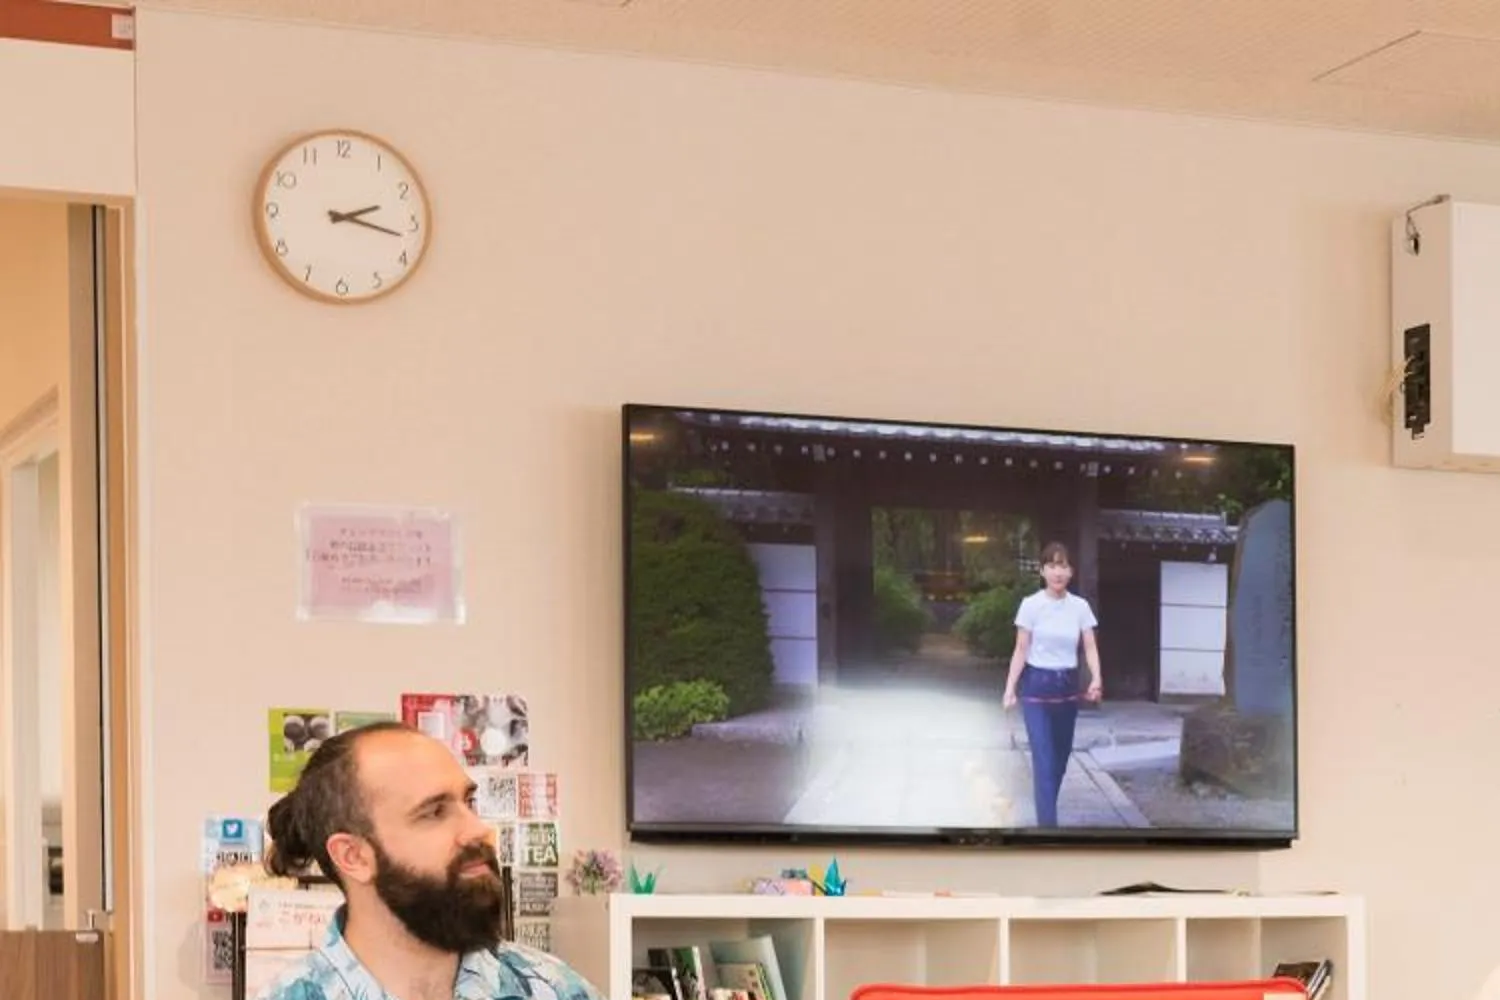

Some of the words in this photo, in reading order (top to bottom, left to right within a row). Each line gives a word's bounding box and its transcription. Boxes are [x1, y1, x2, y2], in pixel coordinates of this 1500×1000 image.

[303, 147, 317, 165] 11
[336, 140, 350, 158] 12
[276, 171, 297, 189] 10
[398, 182, 409, 200] 2
[265, 202, 279, 219] 9
[410, 214, 419, 232] 3
[275, 240, 289, 256] 8
[399, 250, 408, 268] 4
[335, 278, 349, 296] 6
[373, 271, 383, 289] 5
[523, 845, 557, 863] TEA
